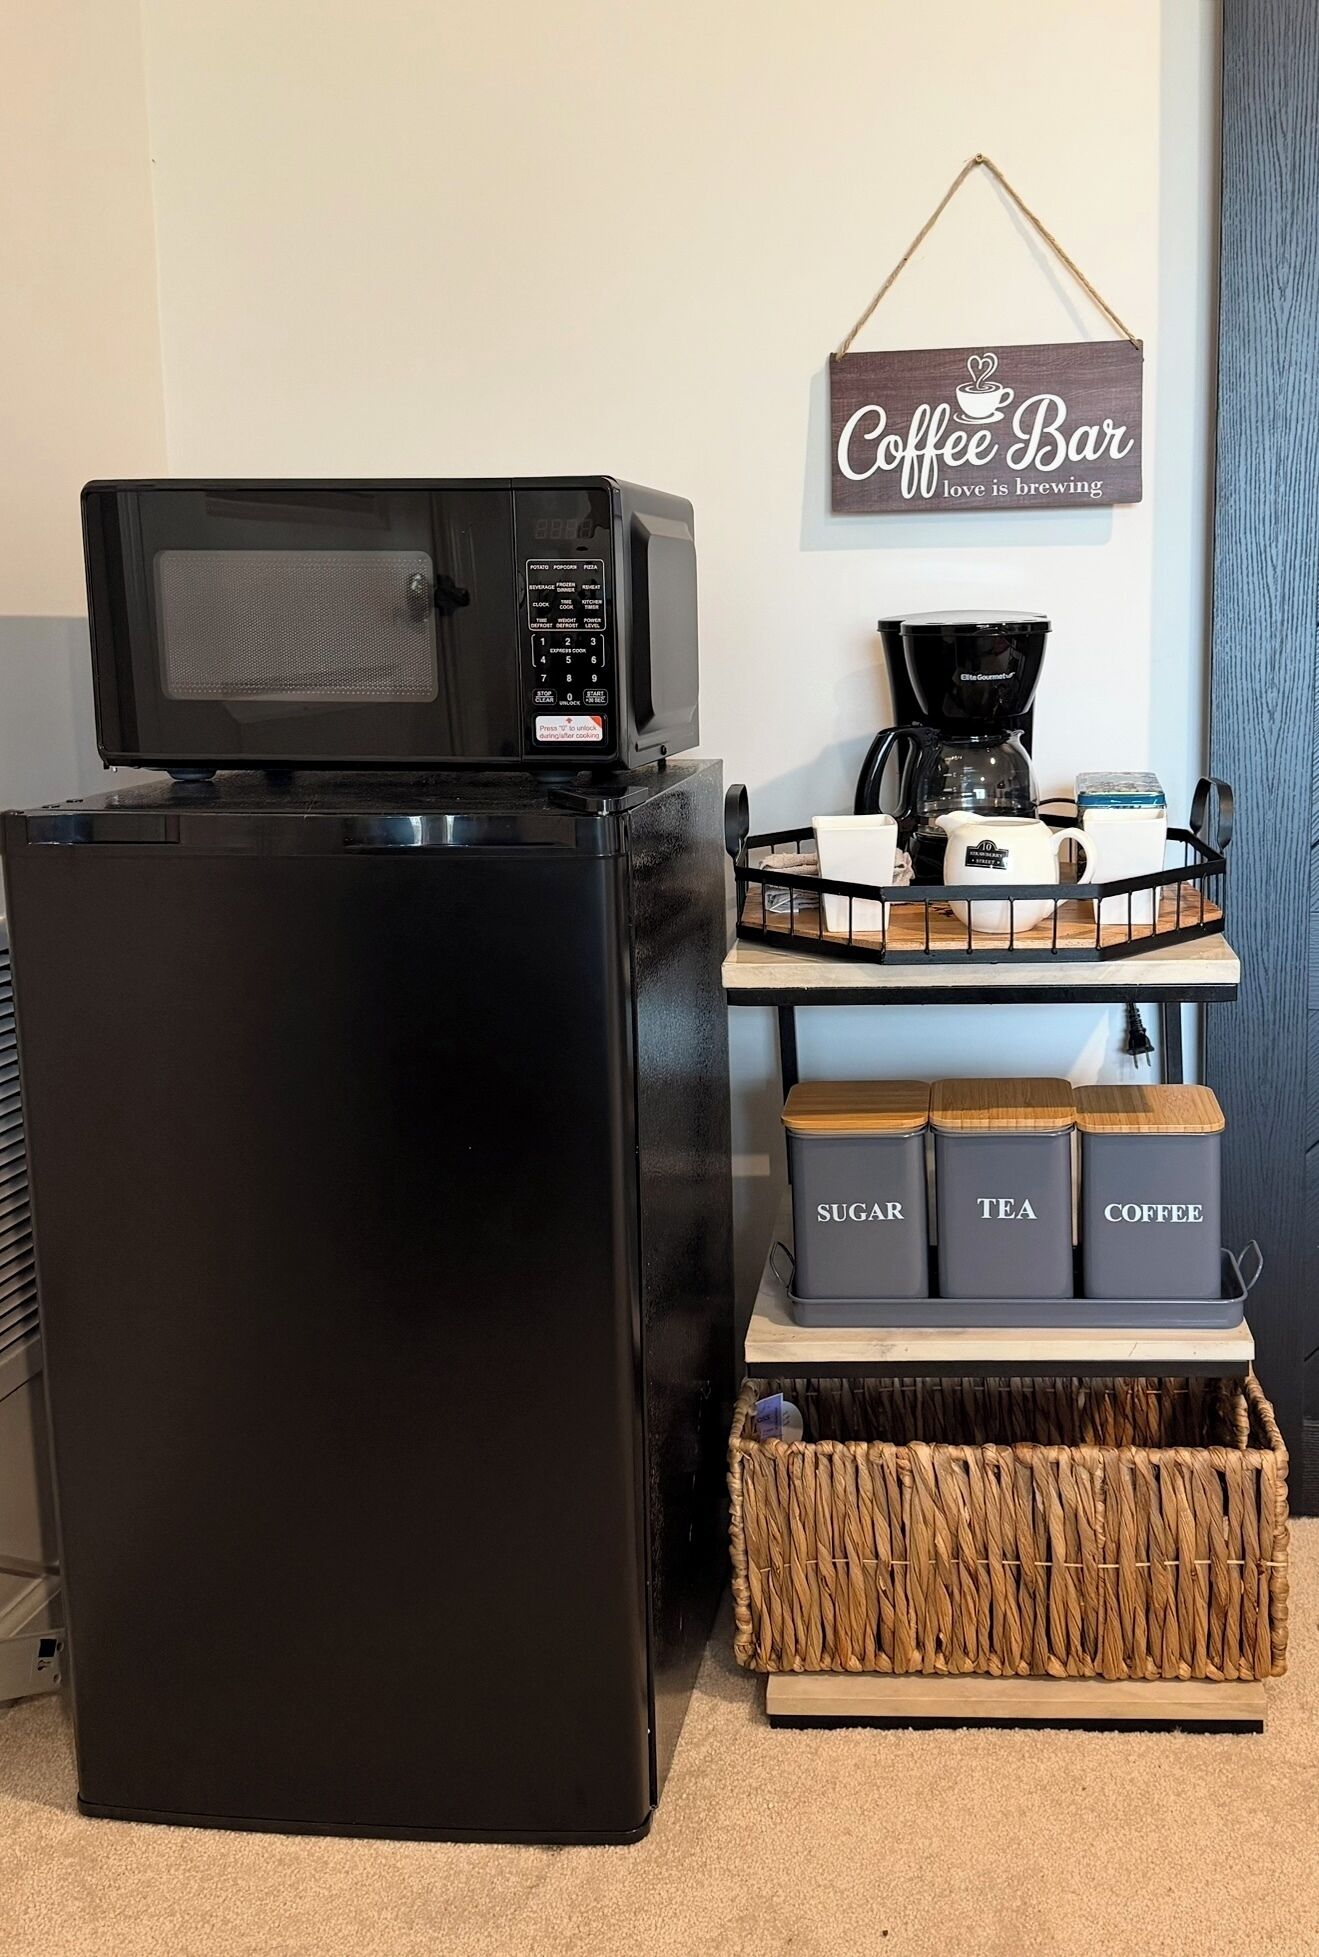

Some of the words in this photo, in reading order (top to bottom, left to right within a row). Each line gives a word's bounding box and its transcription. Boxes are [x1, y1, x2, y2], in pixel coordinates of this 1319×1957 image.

[838, 402, 998, 499] Coffee
[1006, 394, 1134, 472] Bar
[943, 480, 985, 498] love
[992, 478, 1008, 496] is
[1015, 476, 1103, 499] brewing
[540, 638, 545, 646] 1
[565, 637, 571, 646] 2
[590, 638, 596, 646] 3
[565, 656, 572, 664] 5
[591, 656, 597, 664] 6
[541, 674, 547, 682] 7
[566, 674, 572, 682] 8
[591, 674, 598, 682] 9
[566, 693, 573, 701] 0
[575, 732, 600, 740] cooking
[982, 843, 992, 851] 10
[817, 1202, 904, 1223] SUGAR
[977, 1198, 1037, 1220] TEA
[1104, 1203, 1203, 1223] COFFEE
